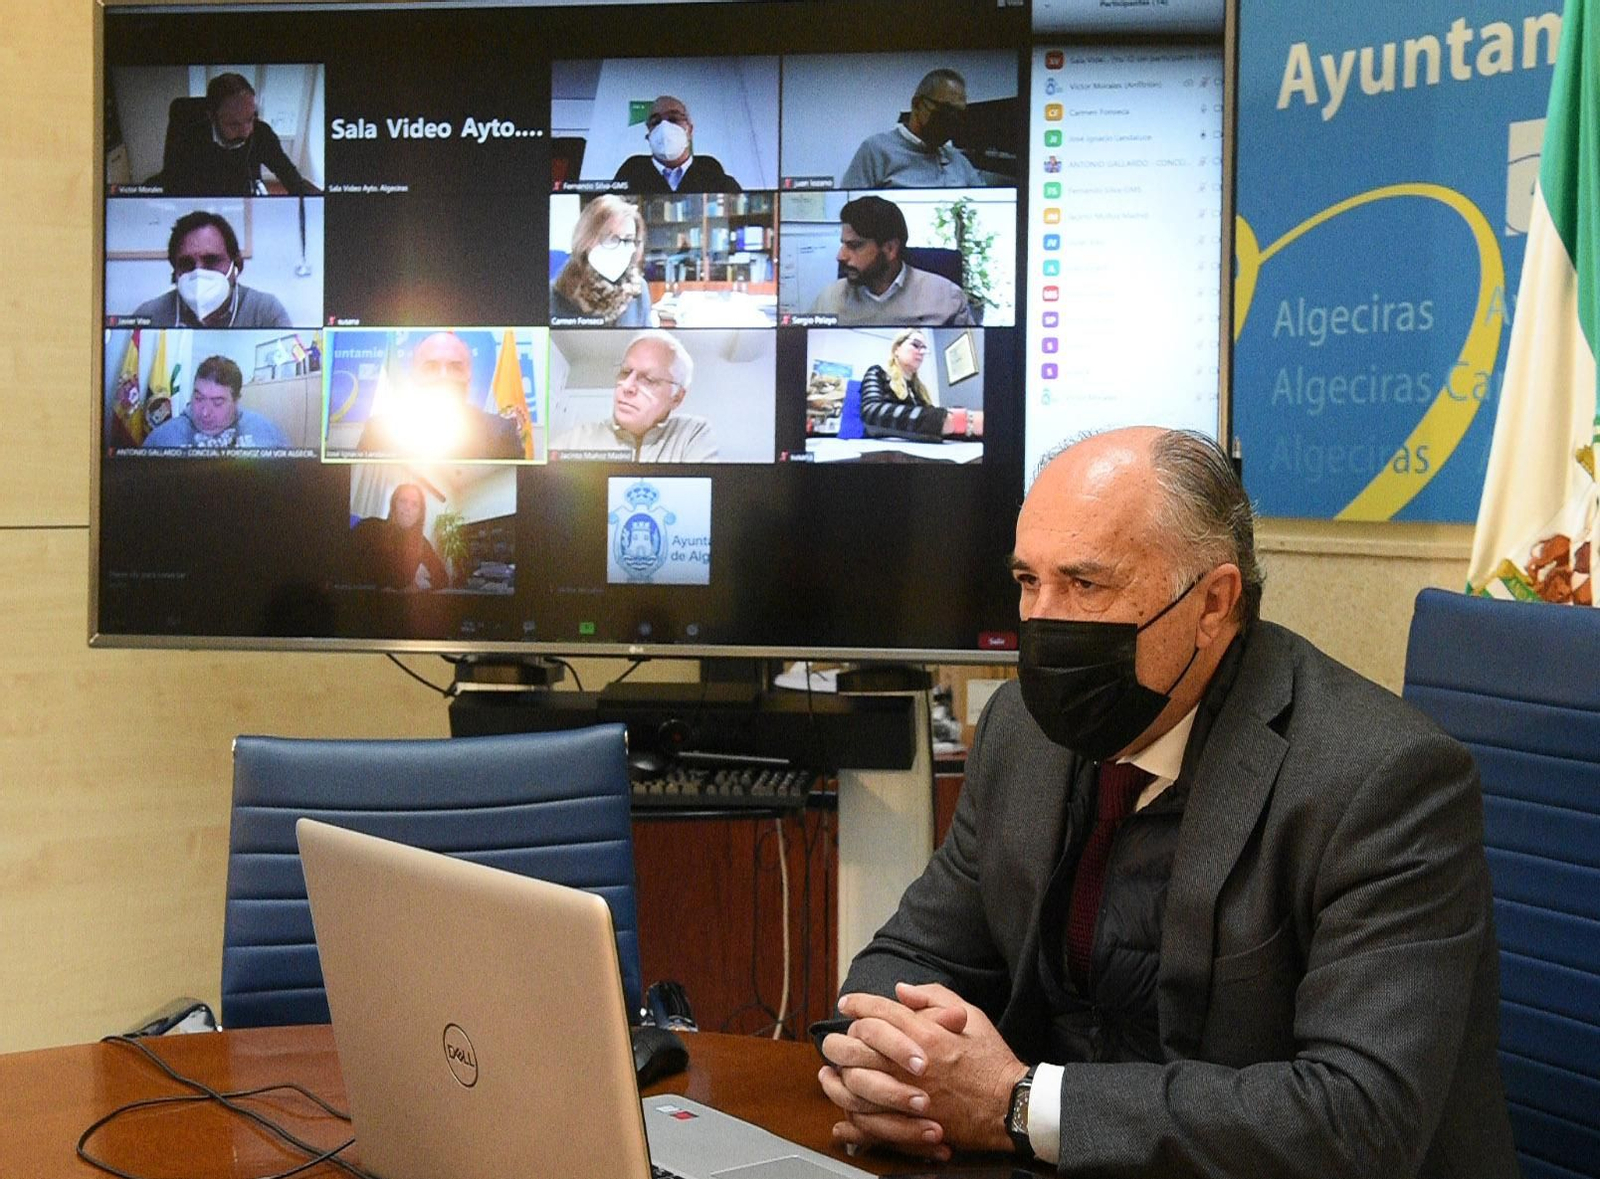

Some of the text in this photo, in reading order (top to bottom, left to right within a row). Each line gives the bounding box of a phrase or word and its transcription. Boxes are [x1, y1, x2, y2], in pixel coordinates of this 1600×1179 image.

[331, 118, 377, 139] Sala
[387, 117, 452, 138] Video
[1273, 293, 1434, 347] Algeciras
[1271, 365, 1432, 416] Algeciras
[671, 550, 686, 561] de
[447, 1043, 475, 1068] DELL
